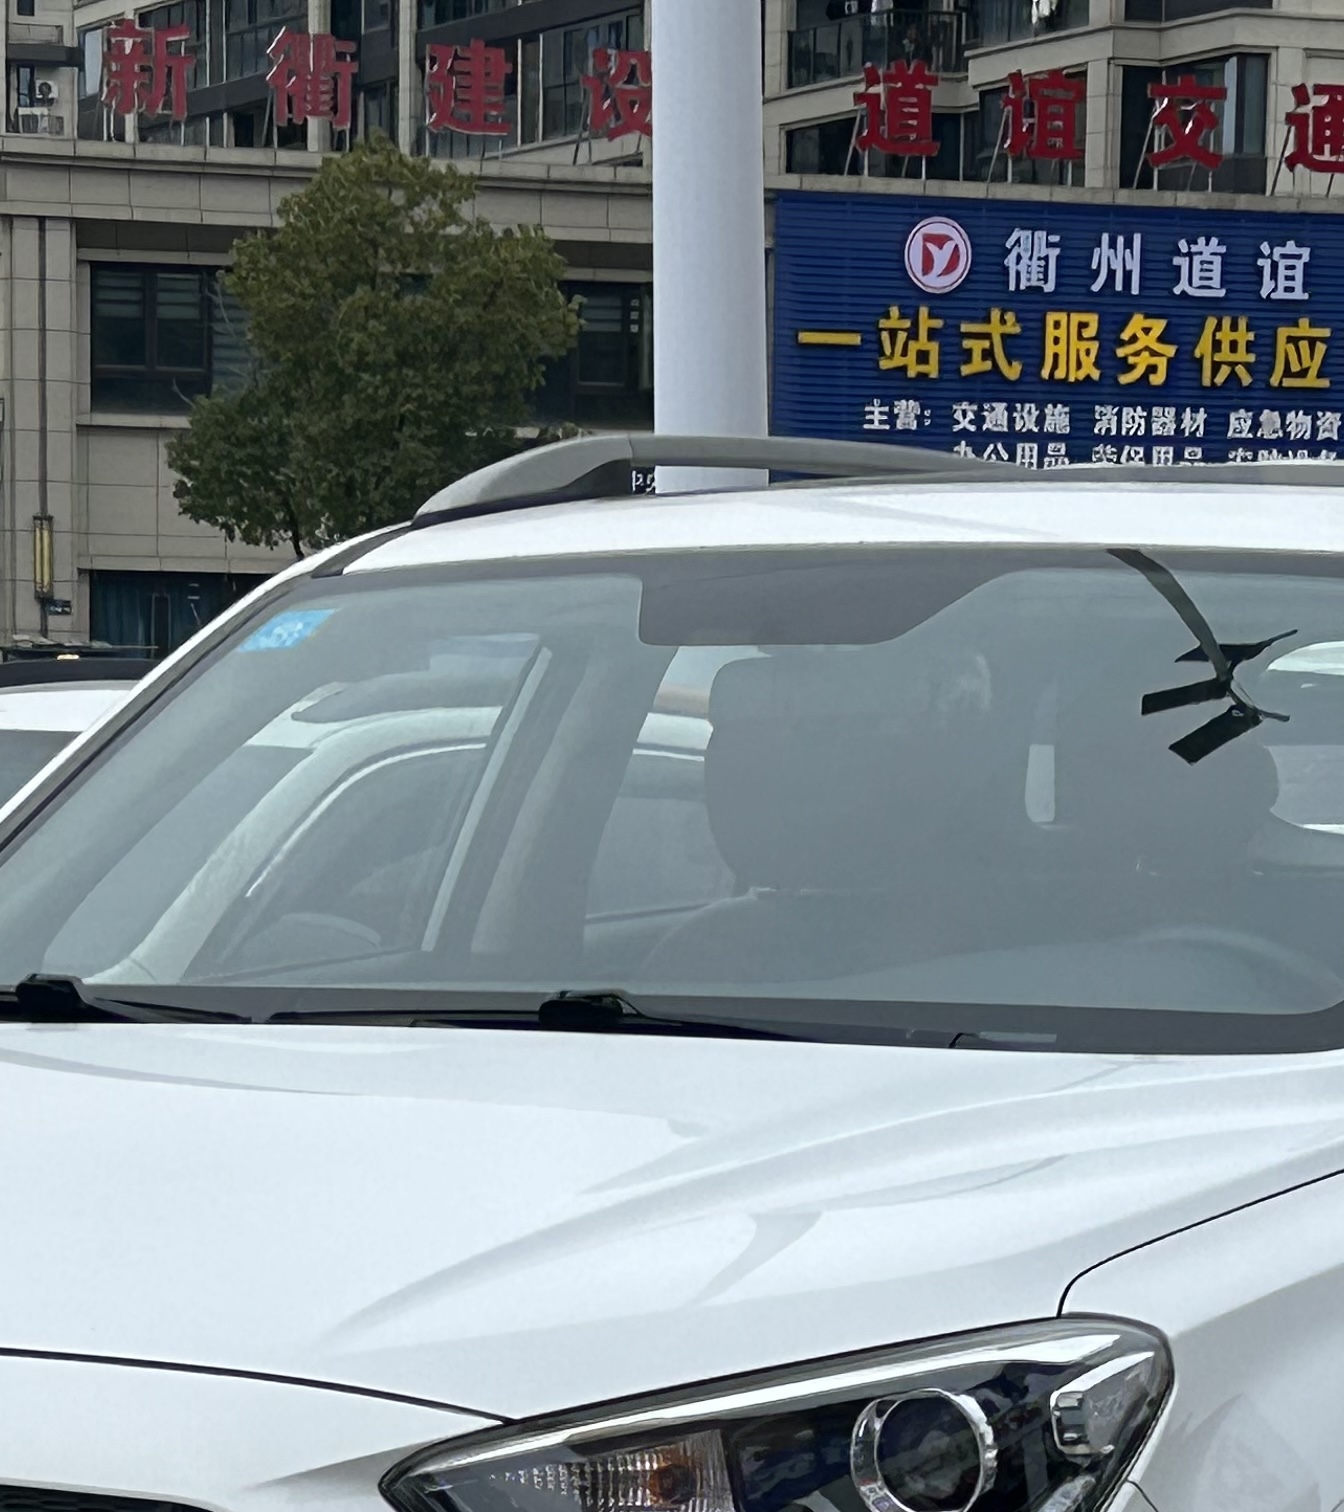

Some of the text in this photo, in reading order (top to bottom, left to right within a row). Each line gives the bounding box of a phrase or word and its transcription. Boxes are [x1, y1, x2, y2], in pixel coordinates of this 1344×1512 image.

[102, 19, 652, 141] 新衢建设
[1003, 227, 1312, 301] 衢州道谊
[951, 401, 1071, 435] 交通设施
[1092, 405, 1208, 438] 消防器材
[1227, 408, 1342, 441] 应急物资
